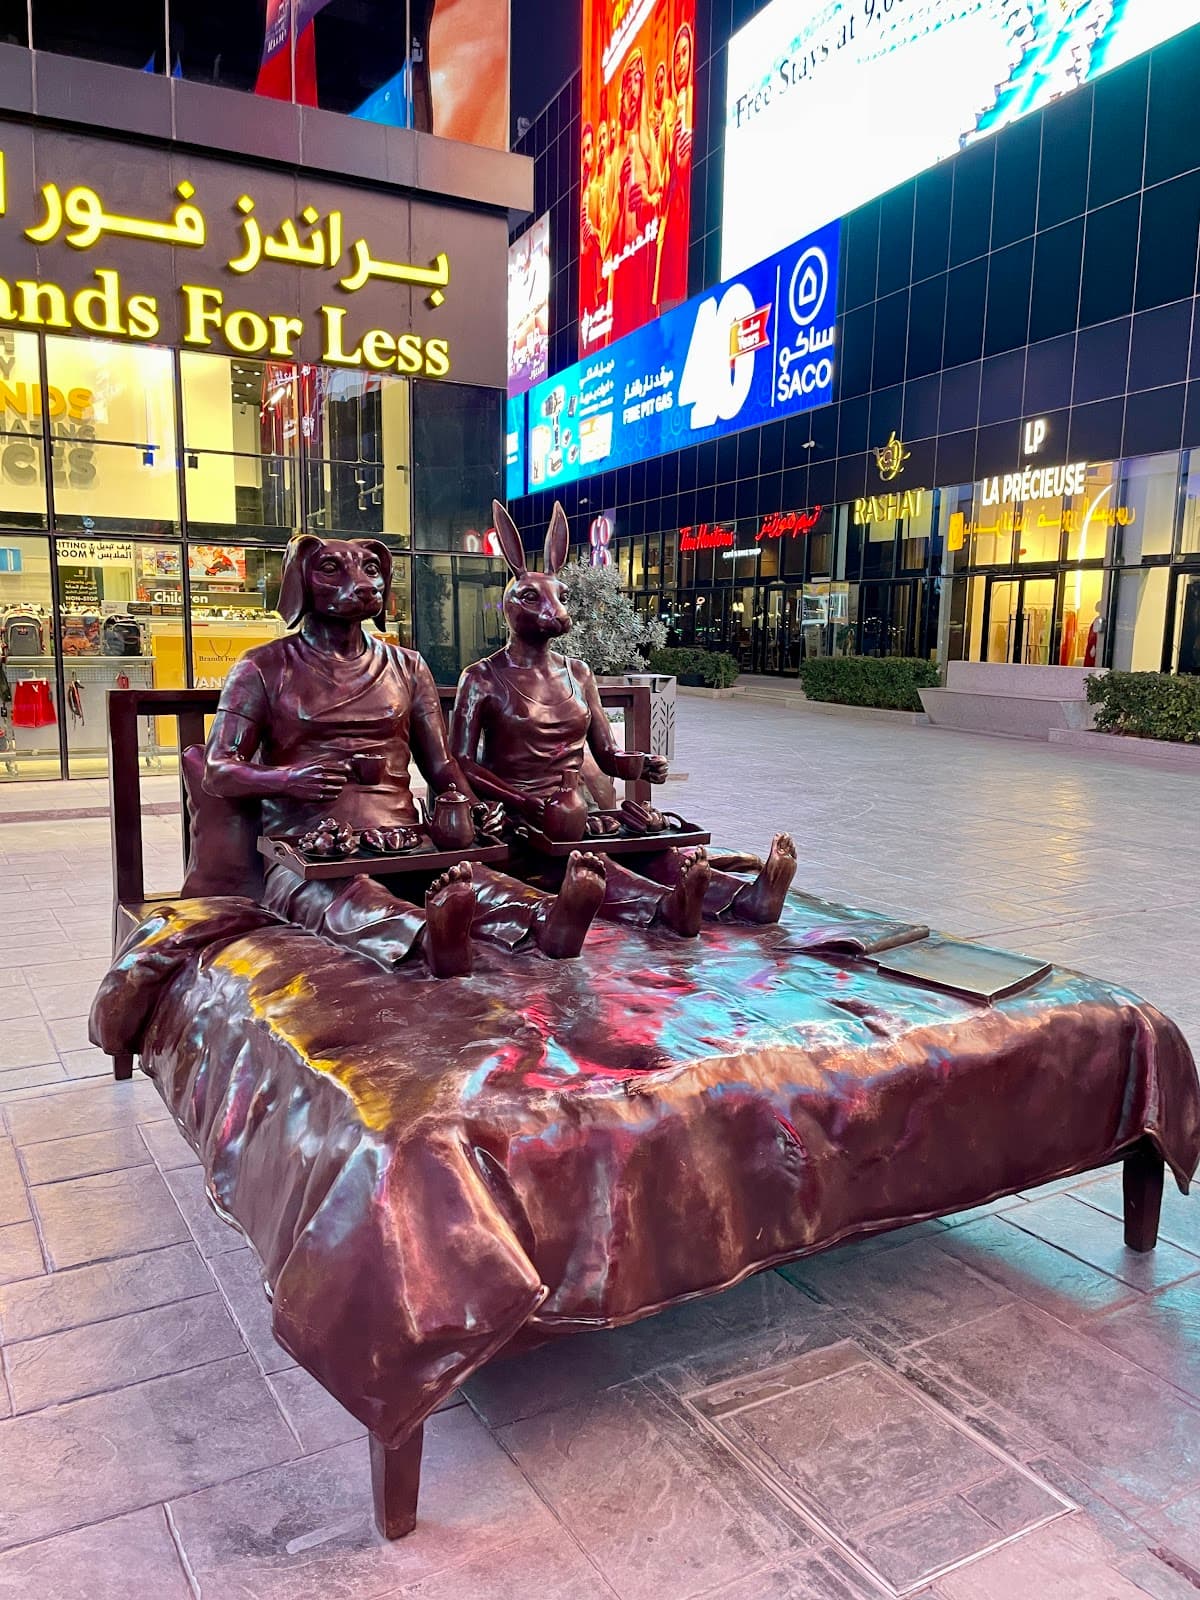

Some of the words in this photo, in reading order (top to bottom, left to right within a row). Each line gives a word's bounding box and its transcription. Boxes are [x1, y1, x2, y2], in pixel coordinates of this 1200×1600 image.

[24, 180, 205, 249] فور
[228, 194, 450, 307] براندز
[182, 285, 303, 357] For
[321, 304, 450, 377] Less
[779, 325, 834, 376] ساكو
[777, 357, 833, 402] SACO
[1024, 420, 1046, 454] LP
[982, 478, 1000, 505] LA
[1002, 463, 1087, 500] PRÉCIEUSE
[854, 487, 926, 525] RASHAT
[56, 541, 87, 549] ITTING
[154, 591, 208, 604] Chilen
